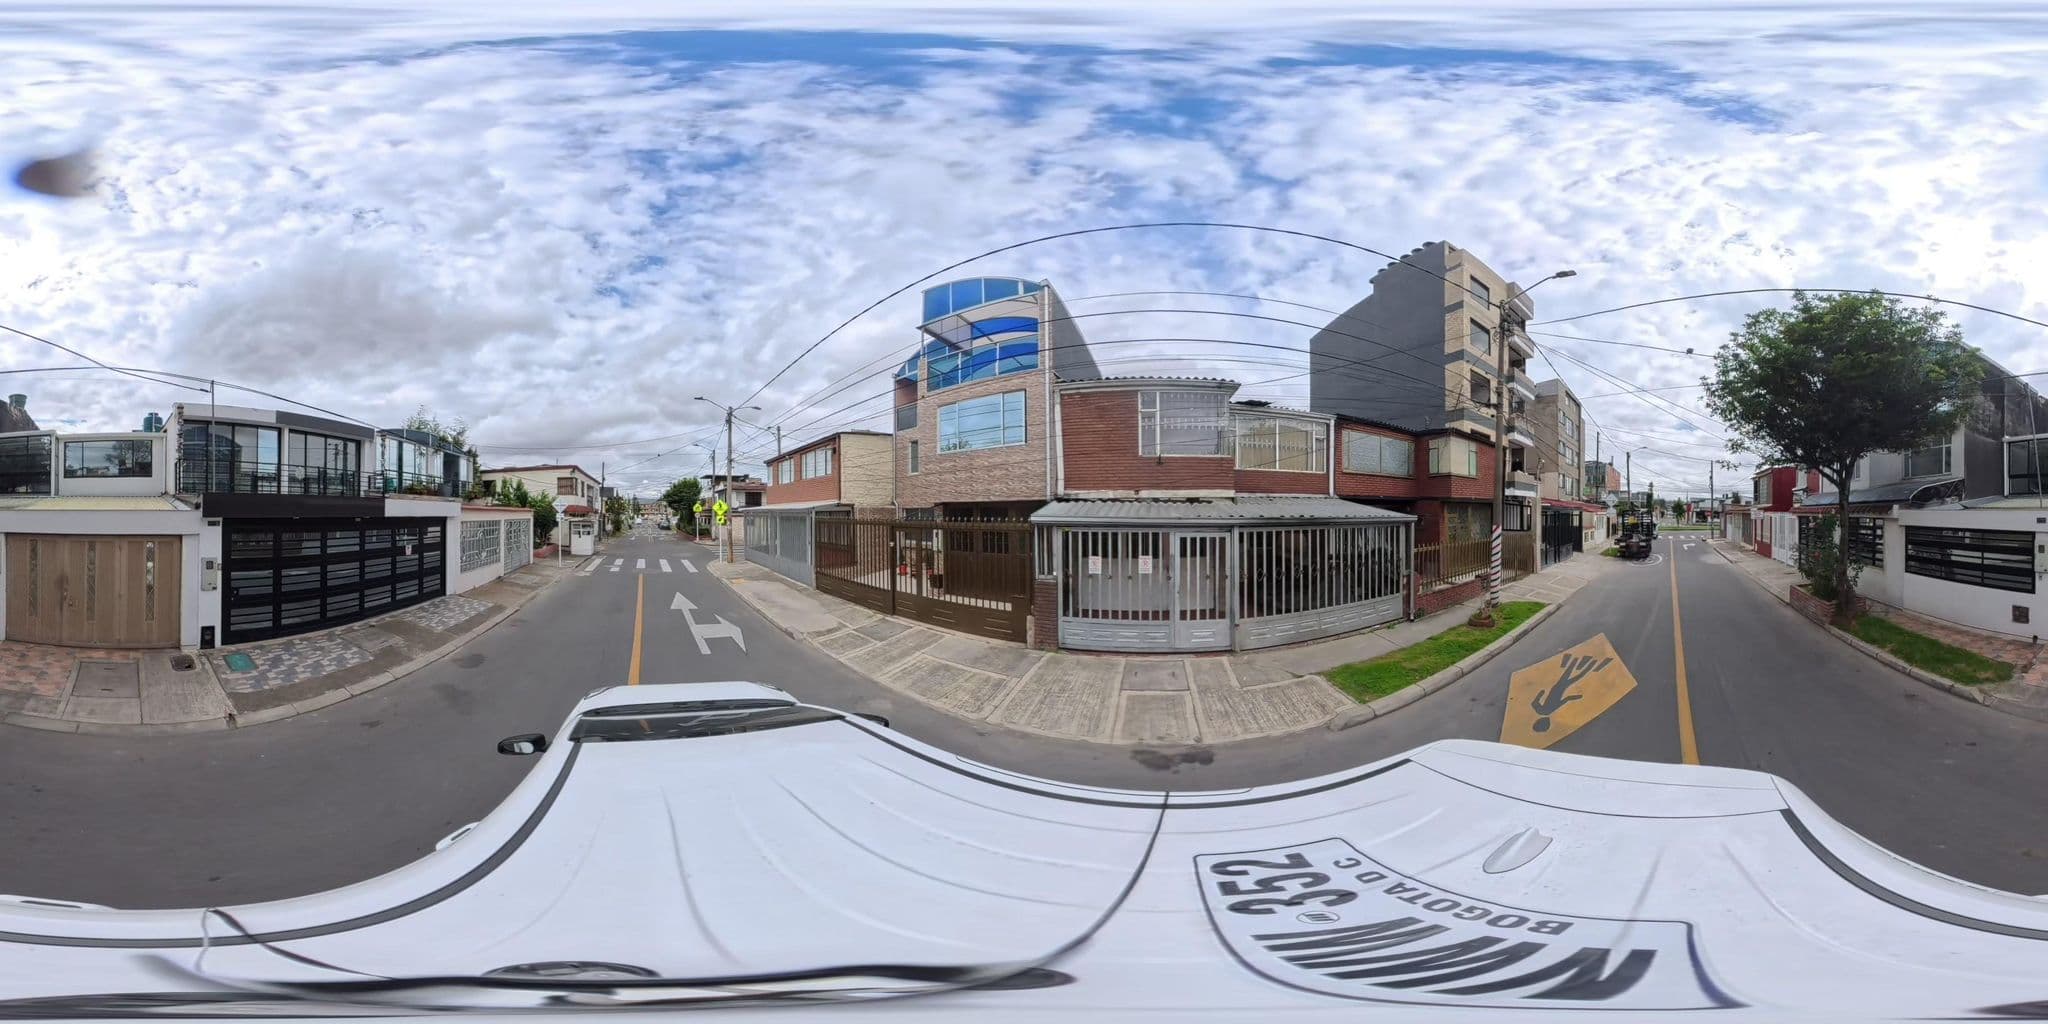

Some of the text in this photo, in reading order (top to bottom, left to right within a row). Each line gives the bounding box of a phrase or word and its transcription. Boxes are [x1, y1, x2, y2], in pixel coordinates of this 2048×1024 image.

[1210, 853, 1658, 1001] NWW 352
[1333, 858, 1574, 935] BOGOTA D C
